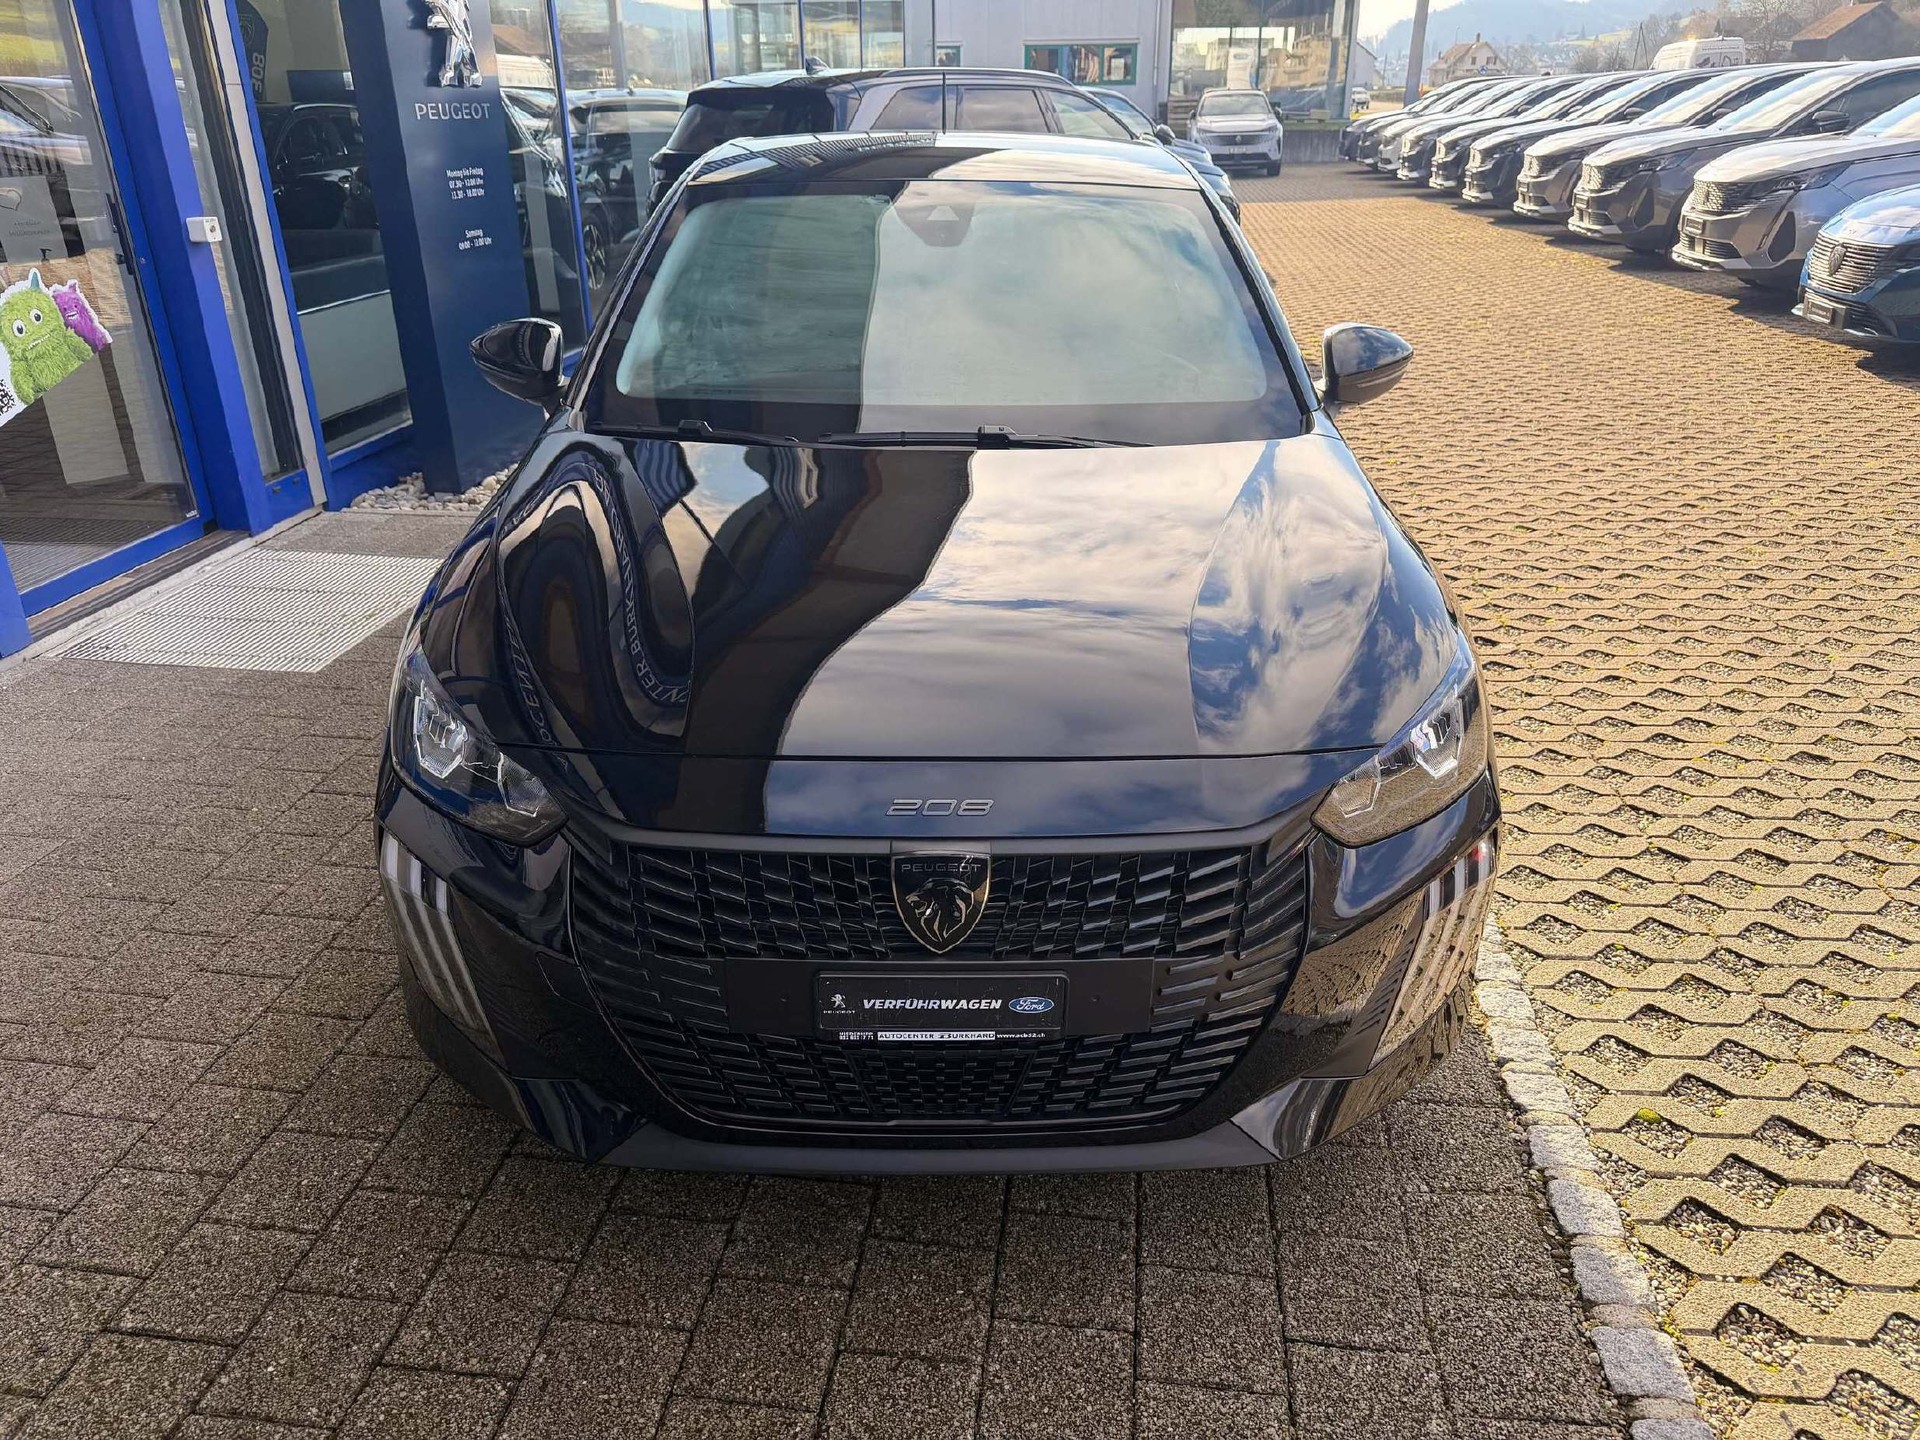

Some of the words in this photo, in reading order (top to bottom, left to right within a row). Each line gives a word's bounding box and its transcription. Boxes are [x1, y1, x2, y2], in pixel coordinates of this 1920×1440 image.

[415, 103, 491, 120] PEUGEOT
[609, 507, 641, 656] BURKHARD
[886, 798, 995, 816] 208
[901, 863, 982, 872] PEUGEOT
[863, 998, 1003, 1010] VERFÜHRWAGEN
[1016, 999, 1046, 1010] Ford
